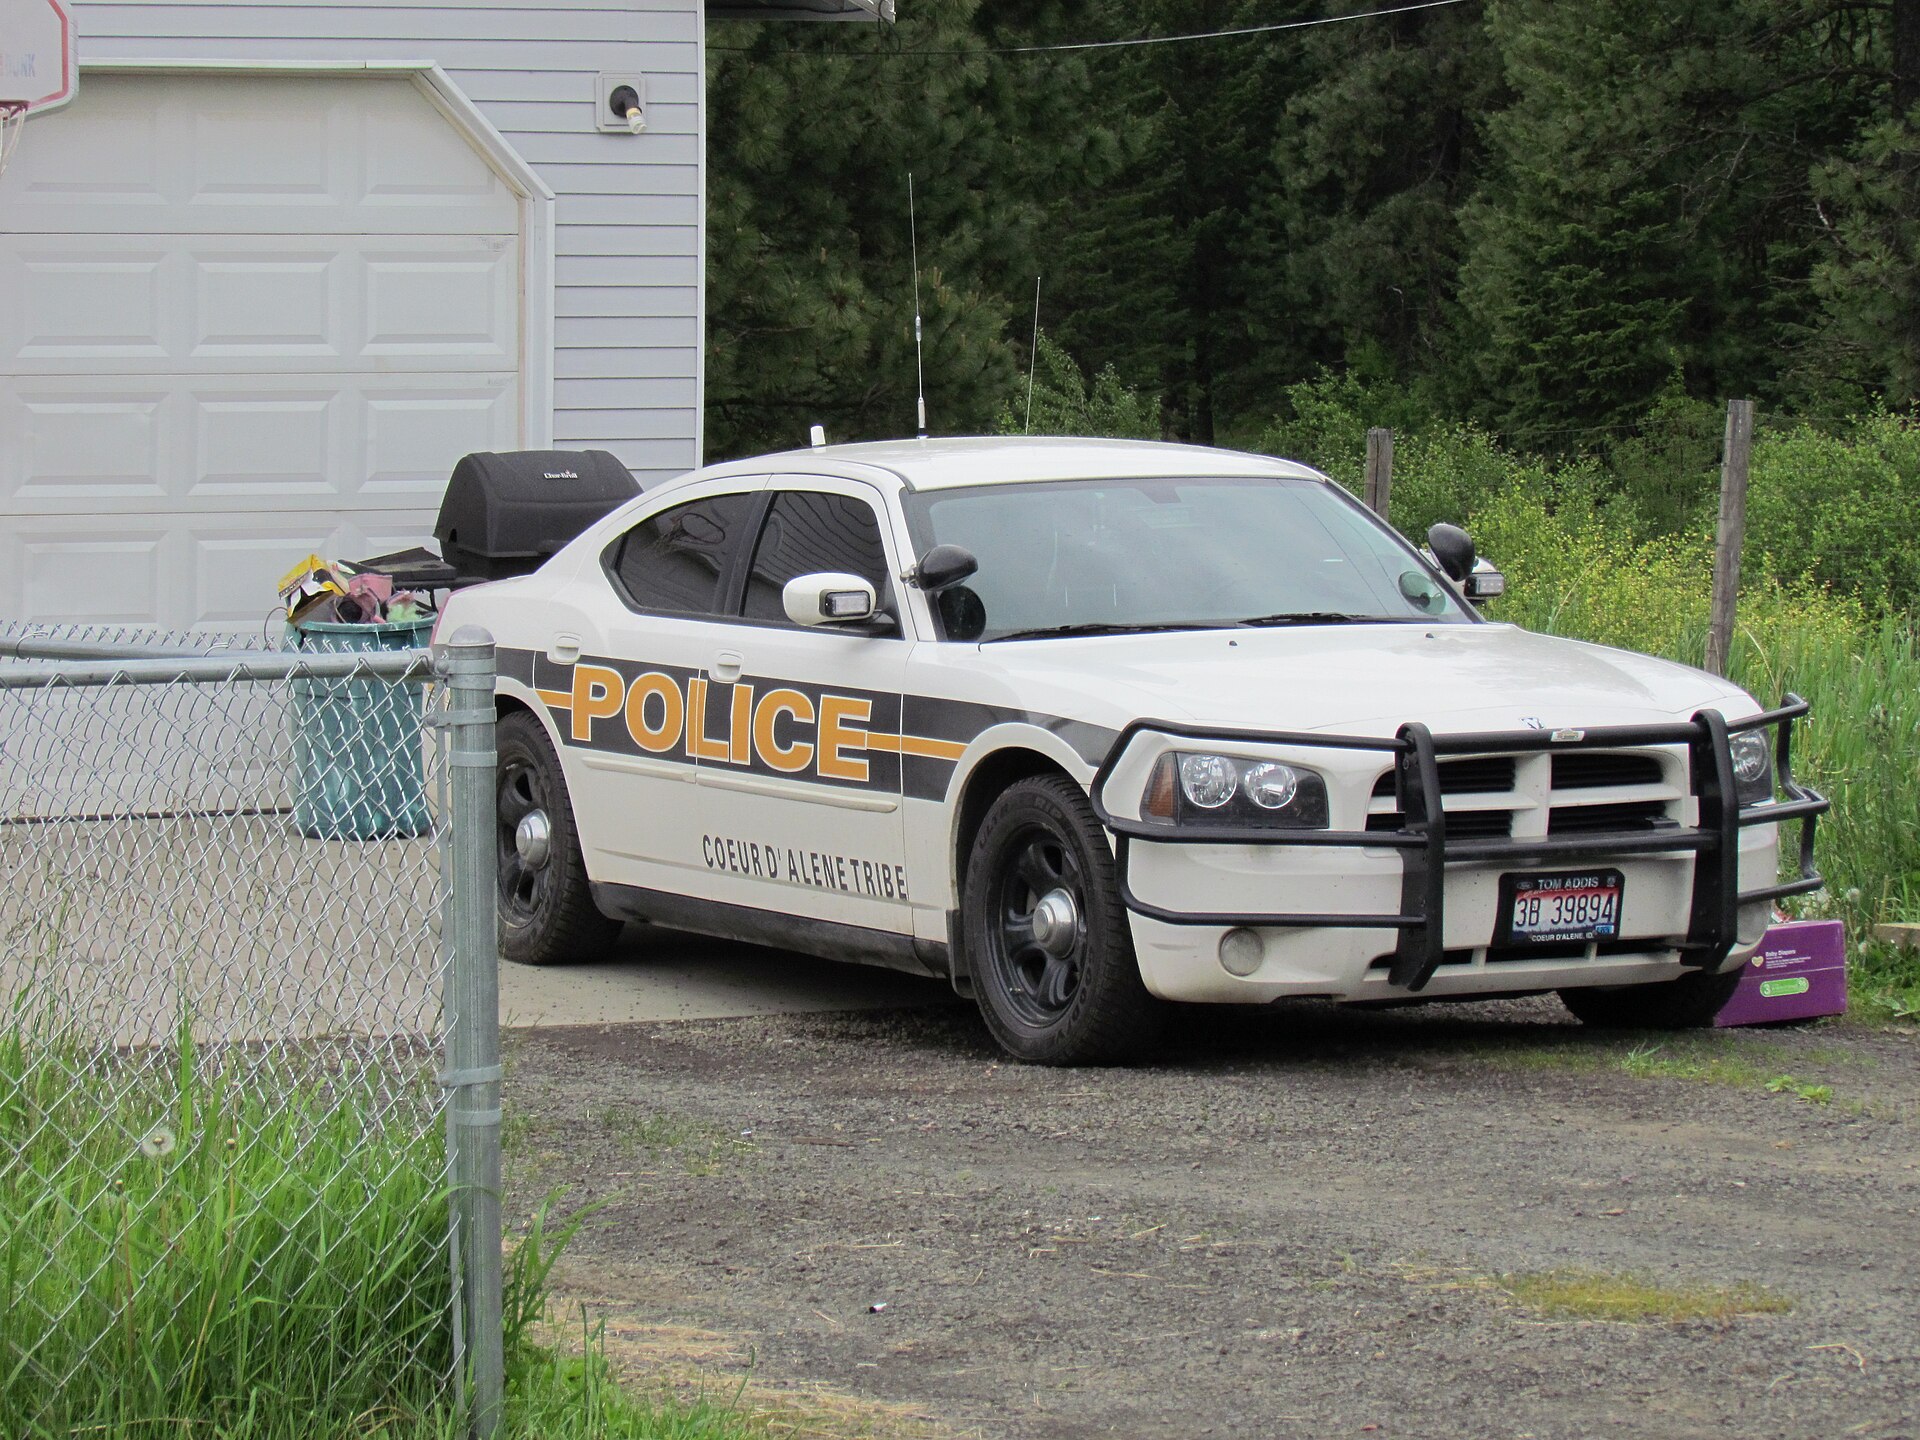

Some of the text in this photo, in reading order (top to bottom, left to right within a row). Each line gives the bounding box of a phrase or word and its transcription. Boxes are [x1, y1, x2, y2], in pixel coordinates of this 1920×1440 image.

[571, 663, 873, 783] POLICE
[702, 834, 763, 877] COEUR
[849, 858, 908, 901] TRIBE
[1538, 879, 1561, 890] TOM
[1564, 876, 1599, 889] ADDIS
[1515, 892, 1615, 927] 3B 39894
[1531, 934, 1555, 942] COEUR
